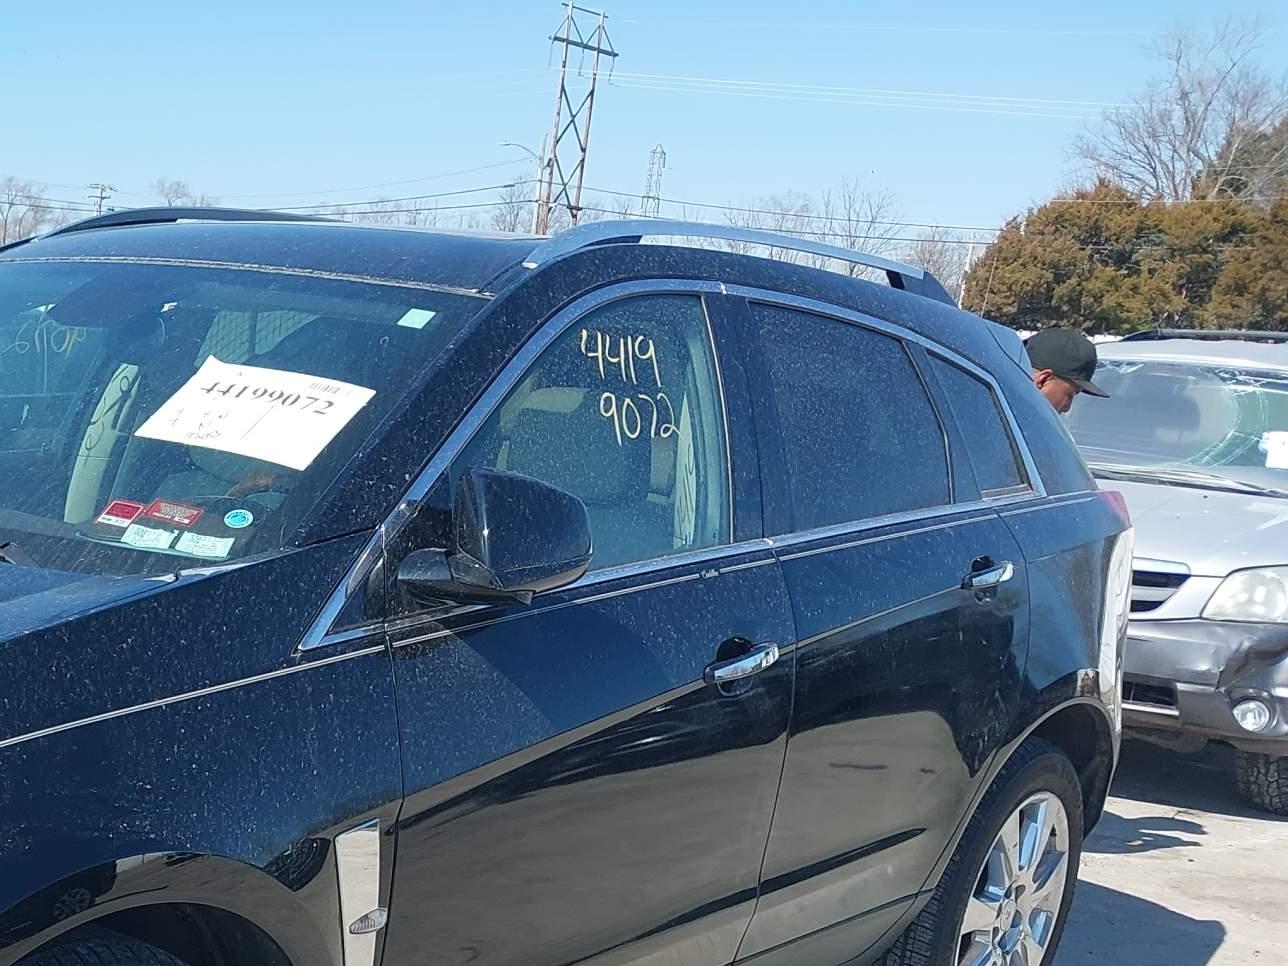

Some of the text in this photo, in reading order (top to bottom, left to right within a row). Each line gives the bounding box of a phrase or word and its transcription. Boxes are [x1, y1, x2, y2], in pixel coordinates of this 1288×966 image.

[580, 328, 662, 388] 4419
[200, 381, 335, 415] 44199072
[599, 391, 681, 446] 9072
